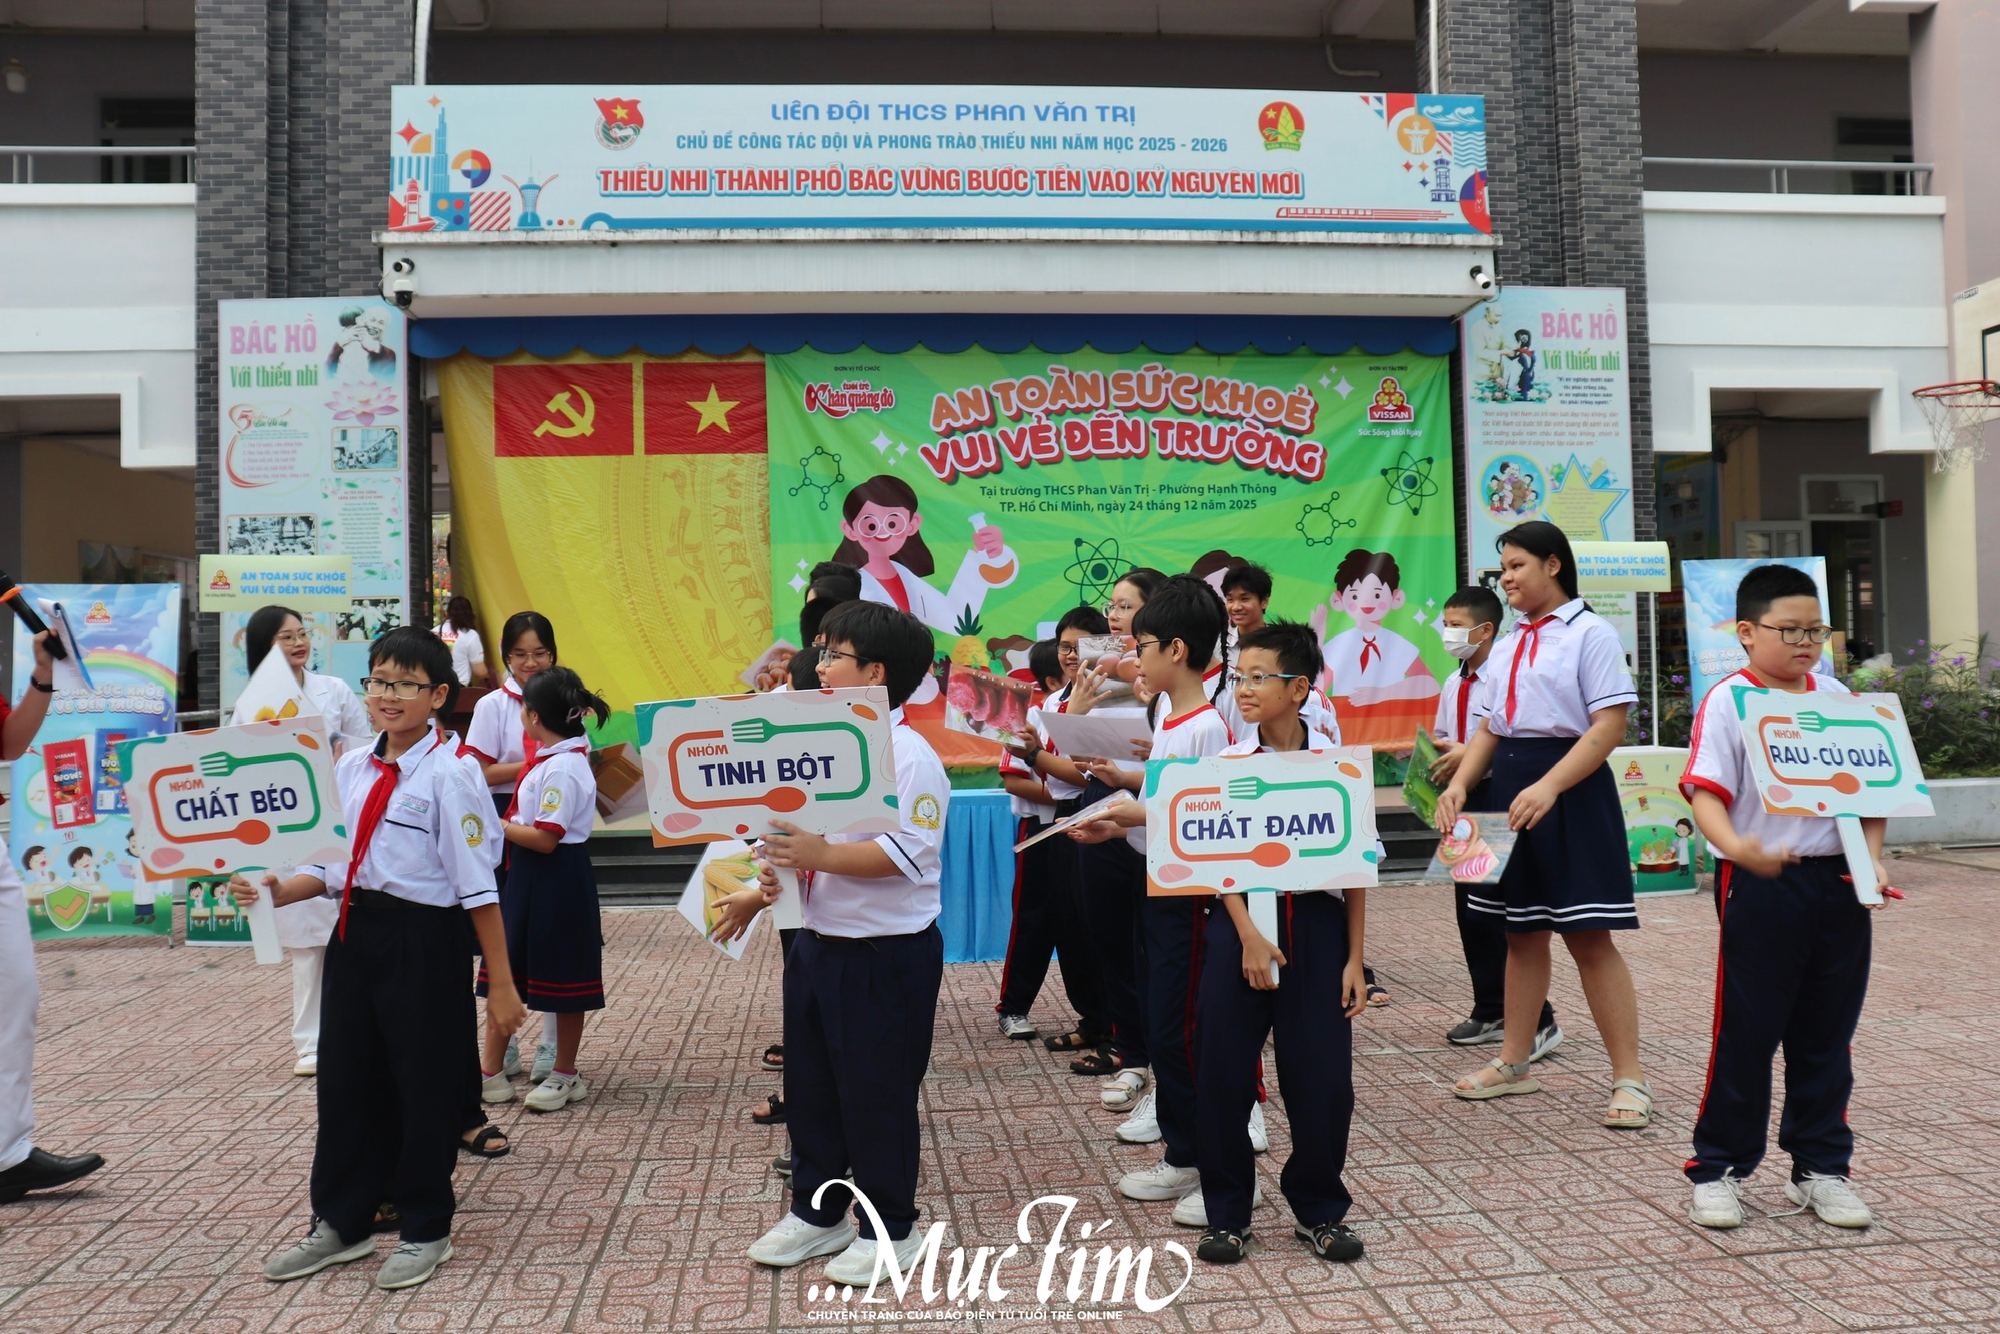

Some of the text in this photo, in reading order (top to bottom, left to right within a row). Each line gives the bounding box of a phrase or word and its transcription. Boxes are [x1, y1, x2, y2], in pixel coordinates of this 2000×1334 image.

[771, 100, 1136, 127] LIÊN ĐỘI THCS PHAN VĂN TRỊ
[676, 130, 708, 149] CHỦ
[713, 130, 733, 149] ĐỀ
[738, 131, 784, 149] CÔNG
[788, 131, 816, 149] TÁC
[821, 132, 848, 152] ĐỘI
[852, 131, 873, 149] VÀ
[878, 134, 932, 149] PHONG
[937, 131, 977, 149] TRÀO
[981, 130, 1026, 149] THIẾU
[1031, 135, 1057, 150] NHI
[1062, 133, 1099, 150] NĂM
[1103, 136, 1134, 153] HỌC
[1139, 137, 1176, 151] 2025
[1191, 138, 1228, 152] 2026
[598, 162, 1303, 196] THIẾU NHI THÀNH PHỐ BÁC VỮNG BƯỚC TIẾN VÀO KỶ NGUYÊN MỚI
[1541, 303, 1618, 340] BÁC HỒ
[229, 312, 317, 355] BÁC HỒ
[1542, 347, 1621, 371] Với thiếu nhi
[229, 361, 319, 388] Với thiếu nhi
[930, 362, 1315, 431] AN TOÀN SỨC KHOẺ
[1373, 411, 1409, 419] VISSAN
[917, 409, 1324, 478] VUI VẺ ĐẾN TRƯỜNG
[980, 485, 997, 499] Tại
[1000, 485, 1041, 499] trường
[1044, 485, 1075, 496] THCS
[1077, 484, 1107, 496] Phan
[1110, 484, 1132, 495] Văn
[1134, 483, 1150, 498] Trị
[1159, 484, 1204, 498] Phường
[1208, 483, 1239, 498] Hạnh
[1241, 483, 1277, 497] Thông
[1000, 499, 1257, 515] TP. Hồ Chí Minh, ngày 24 tháng 12 năm 2025
[1578, 556, 1591, 564] AN
[240, 571, 257, 581] AN
[260, 570, 290, 581] TOÀN
[1578, 567, 1594, 576] VUI
[240, 585, 259, 594] VUI
[1700, 650, 1717, 662] AN
[1700, 661, 1721, 675] VUI
[1773, 728, 1802, 740] NHÓM
[54, 752, 77, 760] VISSAN
[687, 743, 729, 758] NHÓM
[1847, 743, 1893, 767] QUẢ
[698, 752, 835, 787] TINH BỘT
[169, 778, 205, 793] NHÓM
[175, 783, 298, 822] CHẤT BÉO
[1185, 799, 1222, 813] NHÓM
[1181, 810, 1336, 841] CHẤT ĐẠM
